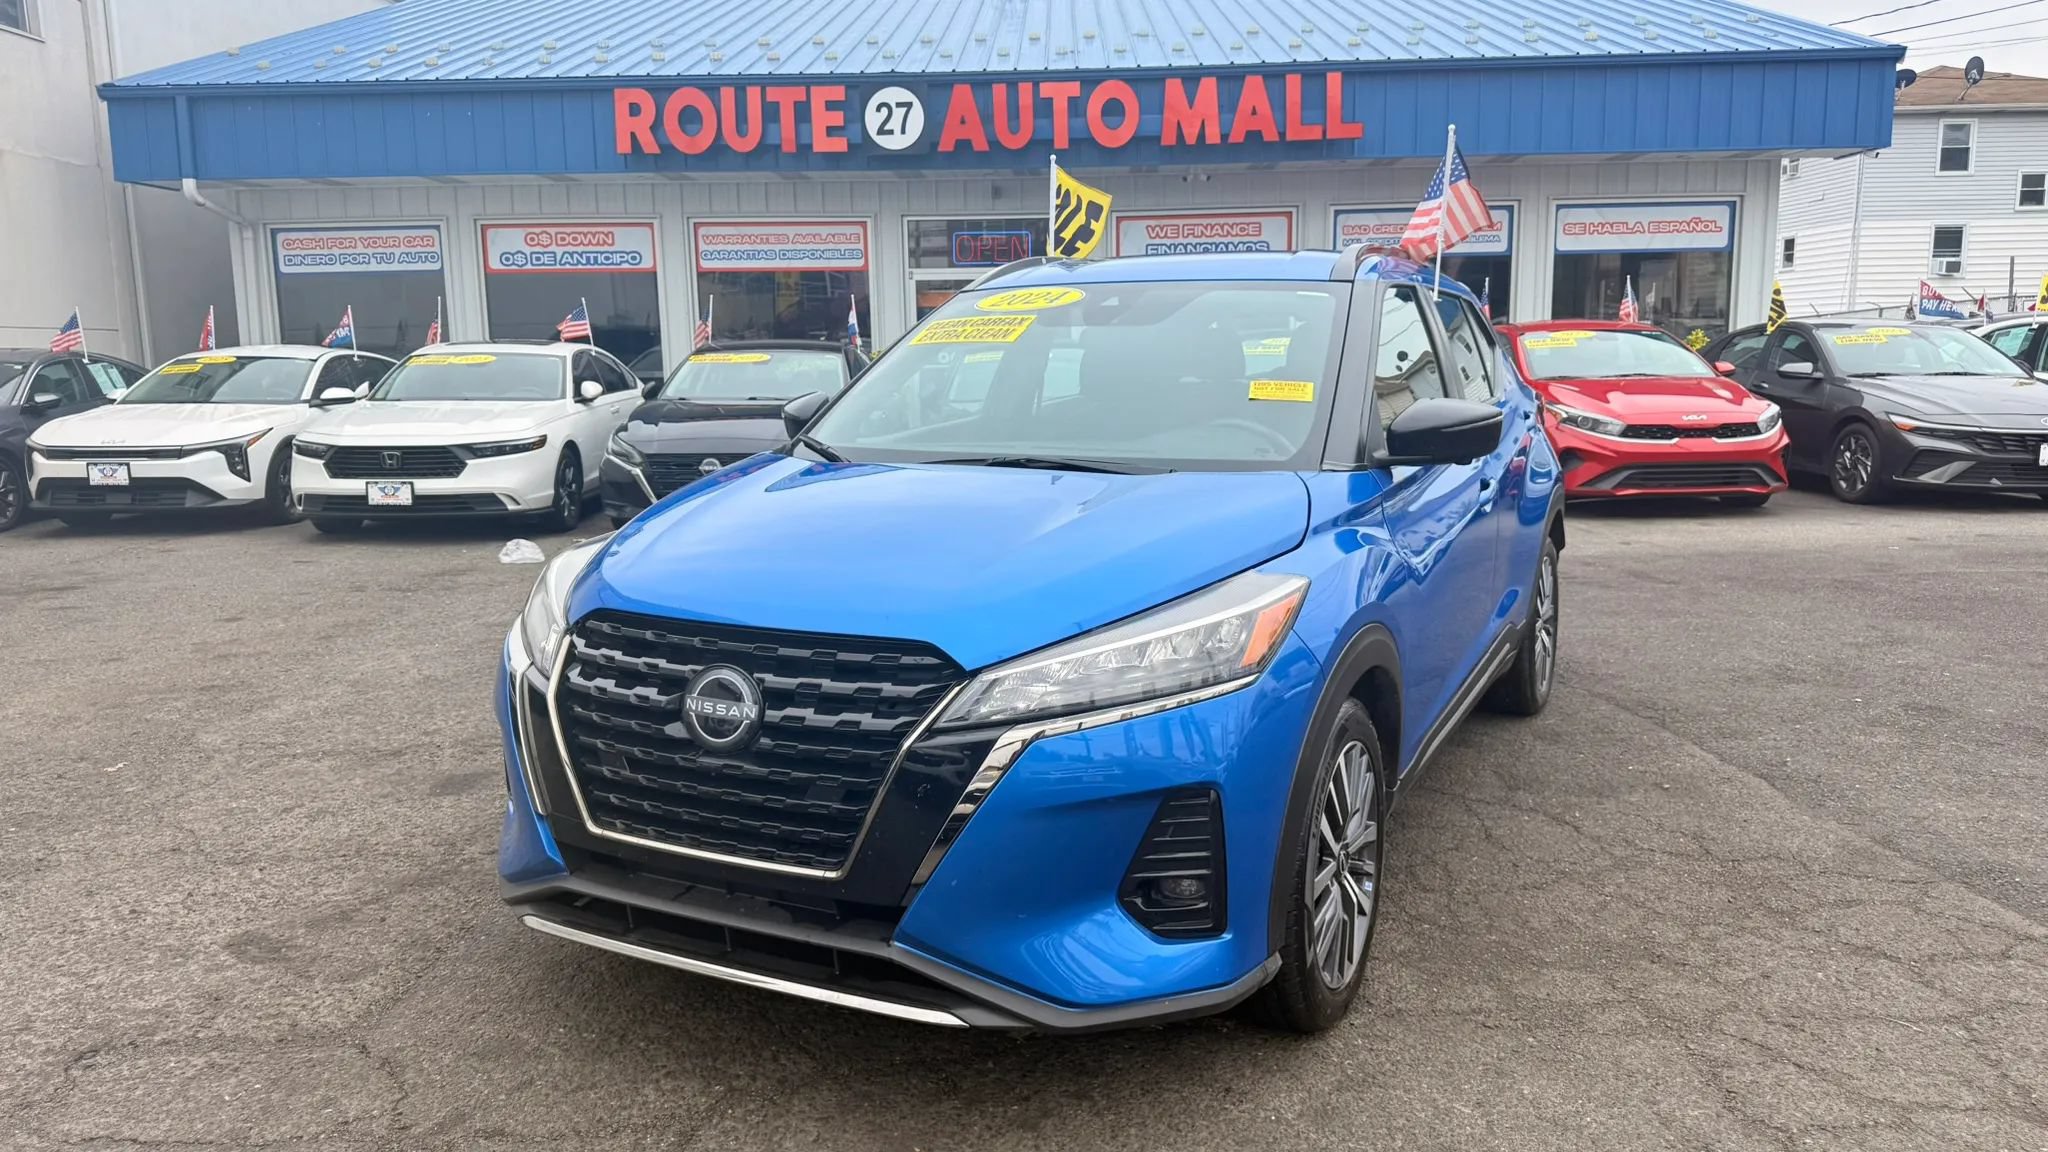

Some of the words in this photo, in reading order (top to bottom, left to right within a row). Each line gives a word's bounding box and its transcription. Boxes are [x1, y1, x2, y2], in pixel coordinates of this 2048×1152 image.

[613, 86, 848, 154] ROUTE
[875, 101, 914, 136] 27
[937, 79, 1140, 153] AUTO
[1160, 72, 1364, 146] MALL
[1145, 224, 1180, 239] WE
[1182, 222, 1262, 238] FINANCE
[1343, 225, 1370, 235] BAD
[1372, 224, 1407, 234] CRED
[1563, 223, 1586, 235] SE
[1588, 223, 1645, 235] HABLA
[1648, 217, 1724, 235] ESPAÑOL
[283, 238, 325, 250] CASH
[327, 237, 357, 249] FOR
[359, 236, 400, 248] YOUR
[402, 235, 435, 248] CAR
[555, 231, 614, 247] DOWN
[791, 233, 861, 244] AVAILABLE
[701, 249, 777, 261] GARANTIAS
[779, 249, 863, 261] DISPONIBLES
[955, 236, 1029, 262] OPEN
[1145, 241, 1270, 256] FINANCIAMOS
[284, 254, 336, 266] DINERO
[338, 253, 370, 265] POR
[373, 253, 395, 264] TU
[397, 252, 439, 264] AUTO
[531, 252, 557, 266] DE
[559, 251, 642, 266] ANTICIPO
[988, 291, 1071, 307] 2024
[1922, 299, 1939, 311] PAY
[926, 318, 970, 331] CLEAN
[970, 316, 1033, 328] CARFAX
[917, 329, 964, 342] EXTRA
[963, 327, 1017, 340] CLEAN
[686, 698, 756, 719] NISSAN
